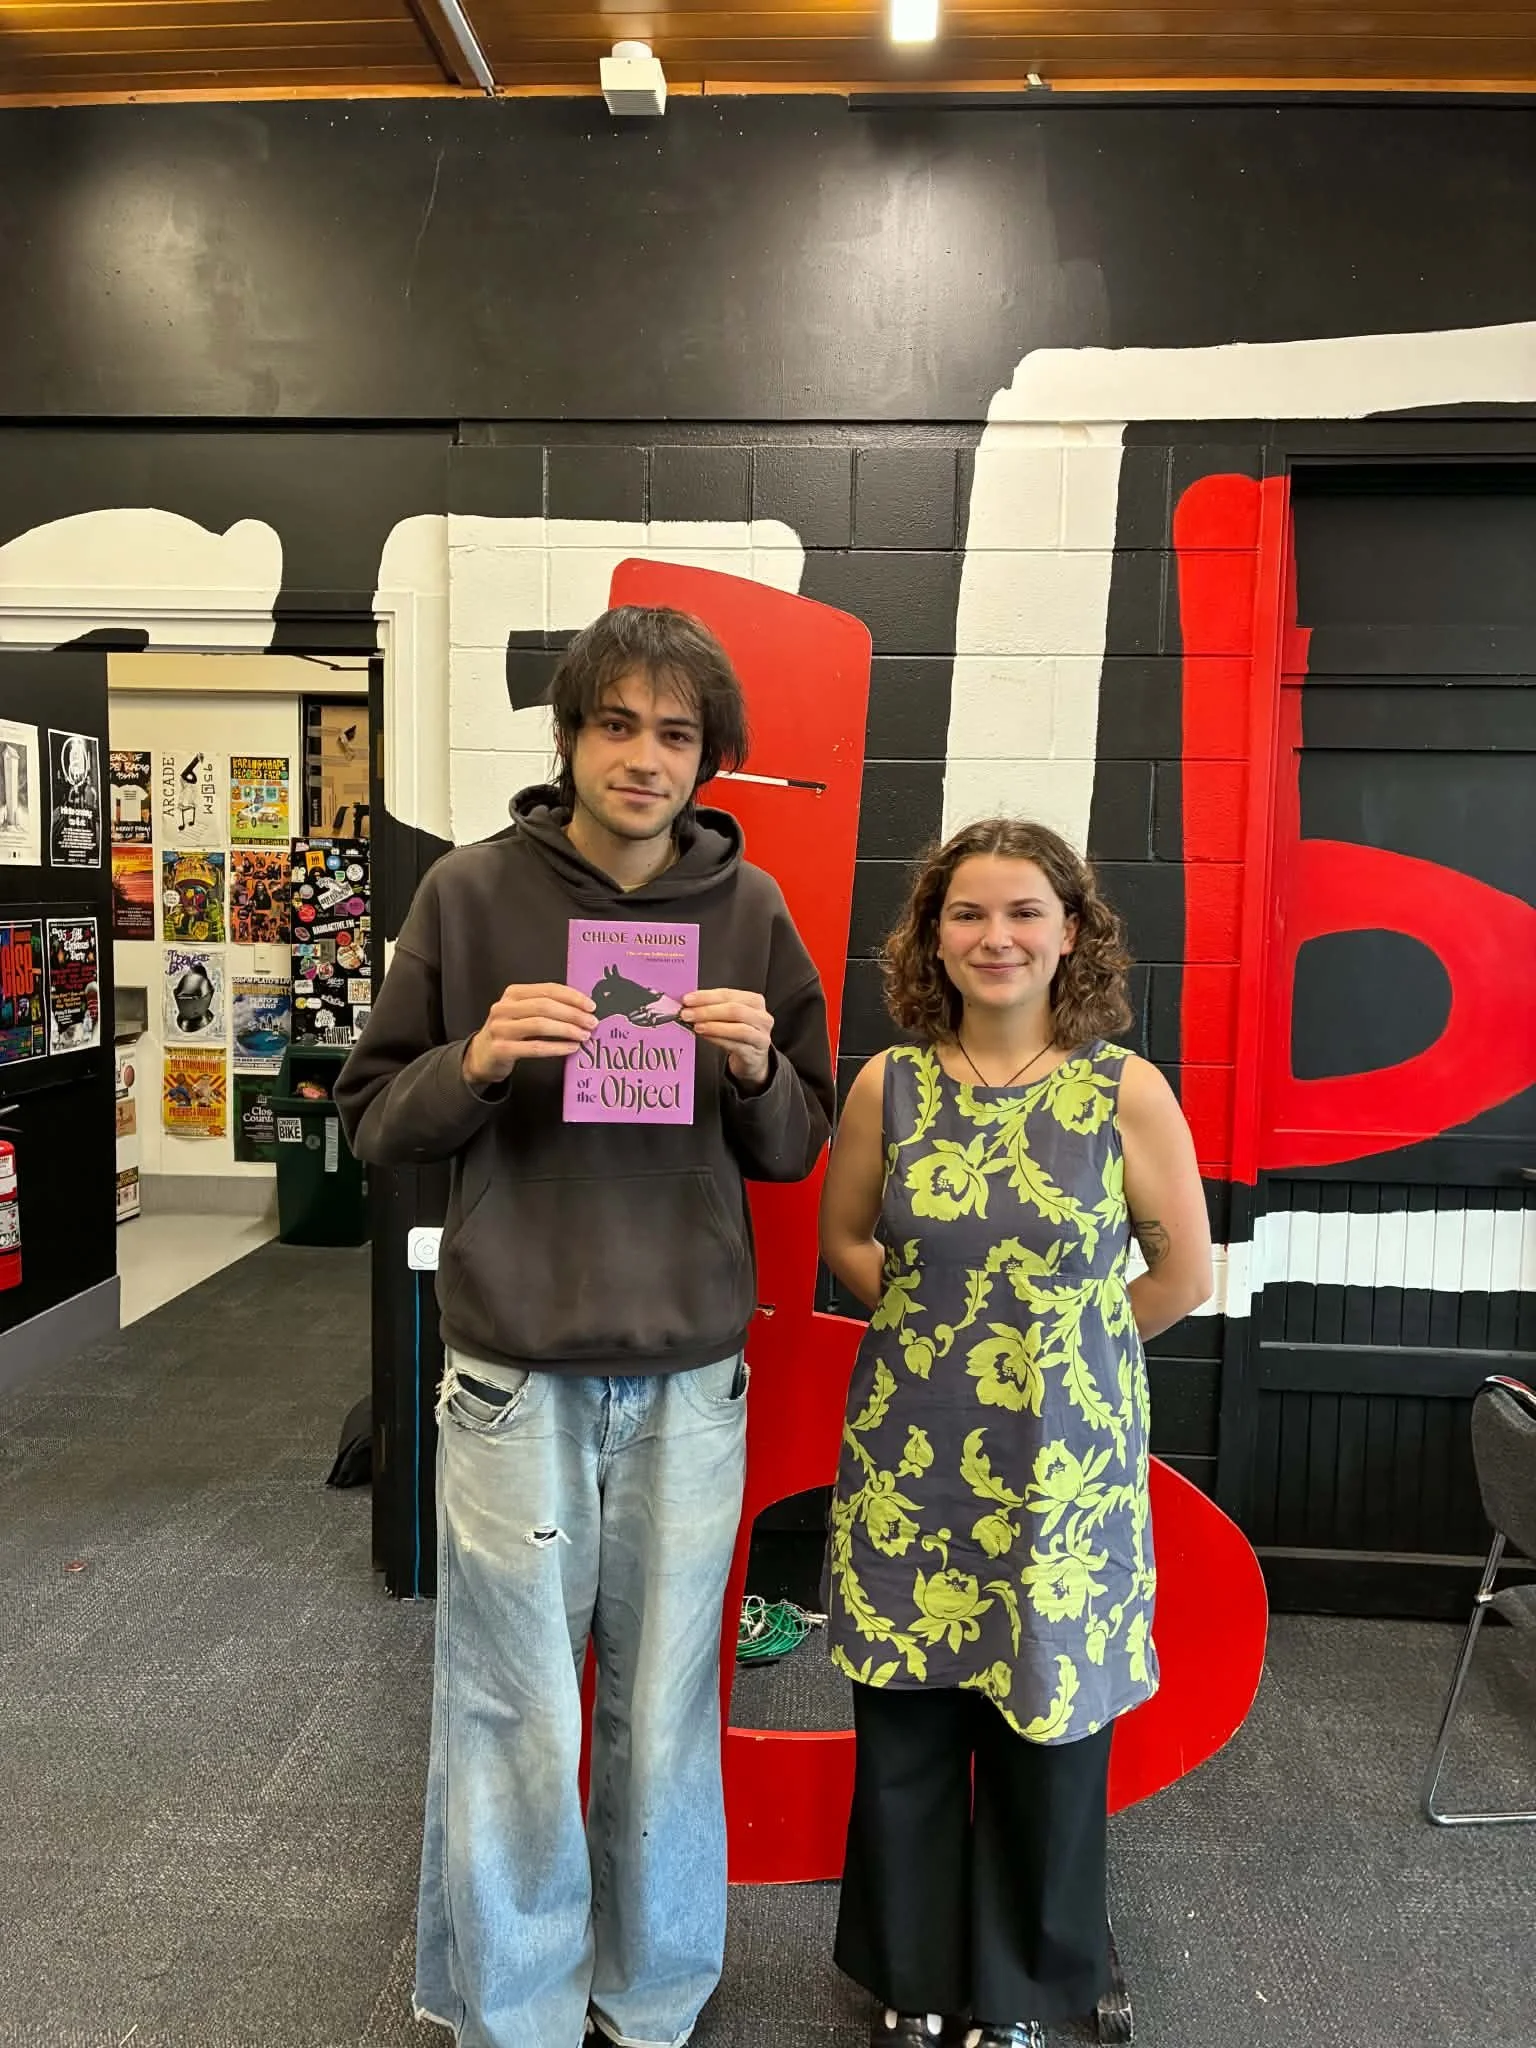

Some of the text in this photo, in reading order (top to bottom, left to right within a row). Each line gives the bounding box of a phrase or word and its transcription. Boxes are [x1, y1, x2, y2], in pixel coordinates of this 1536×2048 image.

[233, 769, 281, 780] RECORD FAIR
[162, 757, 175, 817] ARCADE
[582, 931, 686, 946] CHLOE ARIDJIS
[610, 1028, 630, 1039] the
[578, 1039, 683, 1072] Shadow
[577, 1077, 592, 1089] of
[577, 1075, 681, 1114] the Object
[279, 1126, 301, 1139] BIKE
